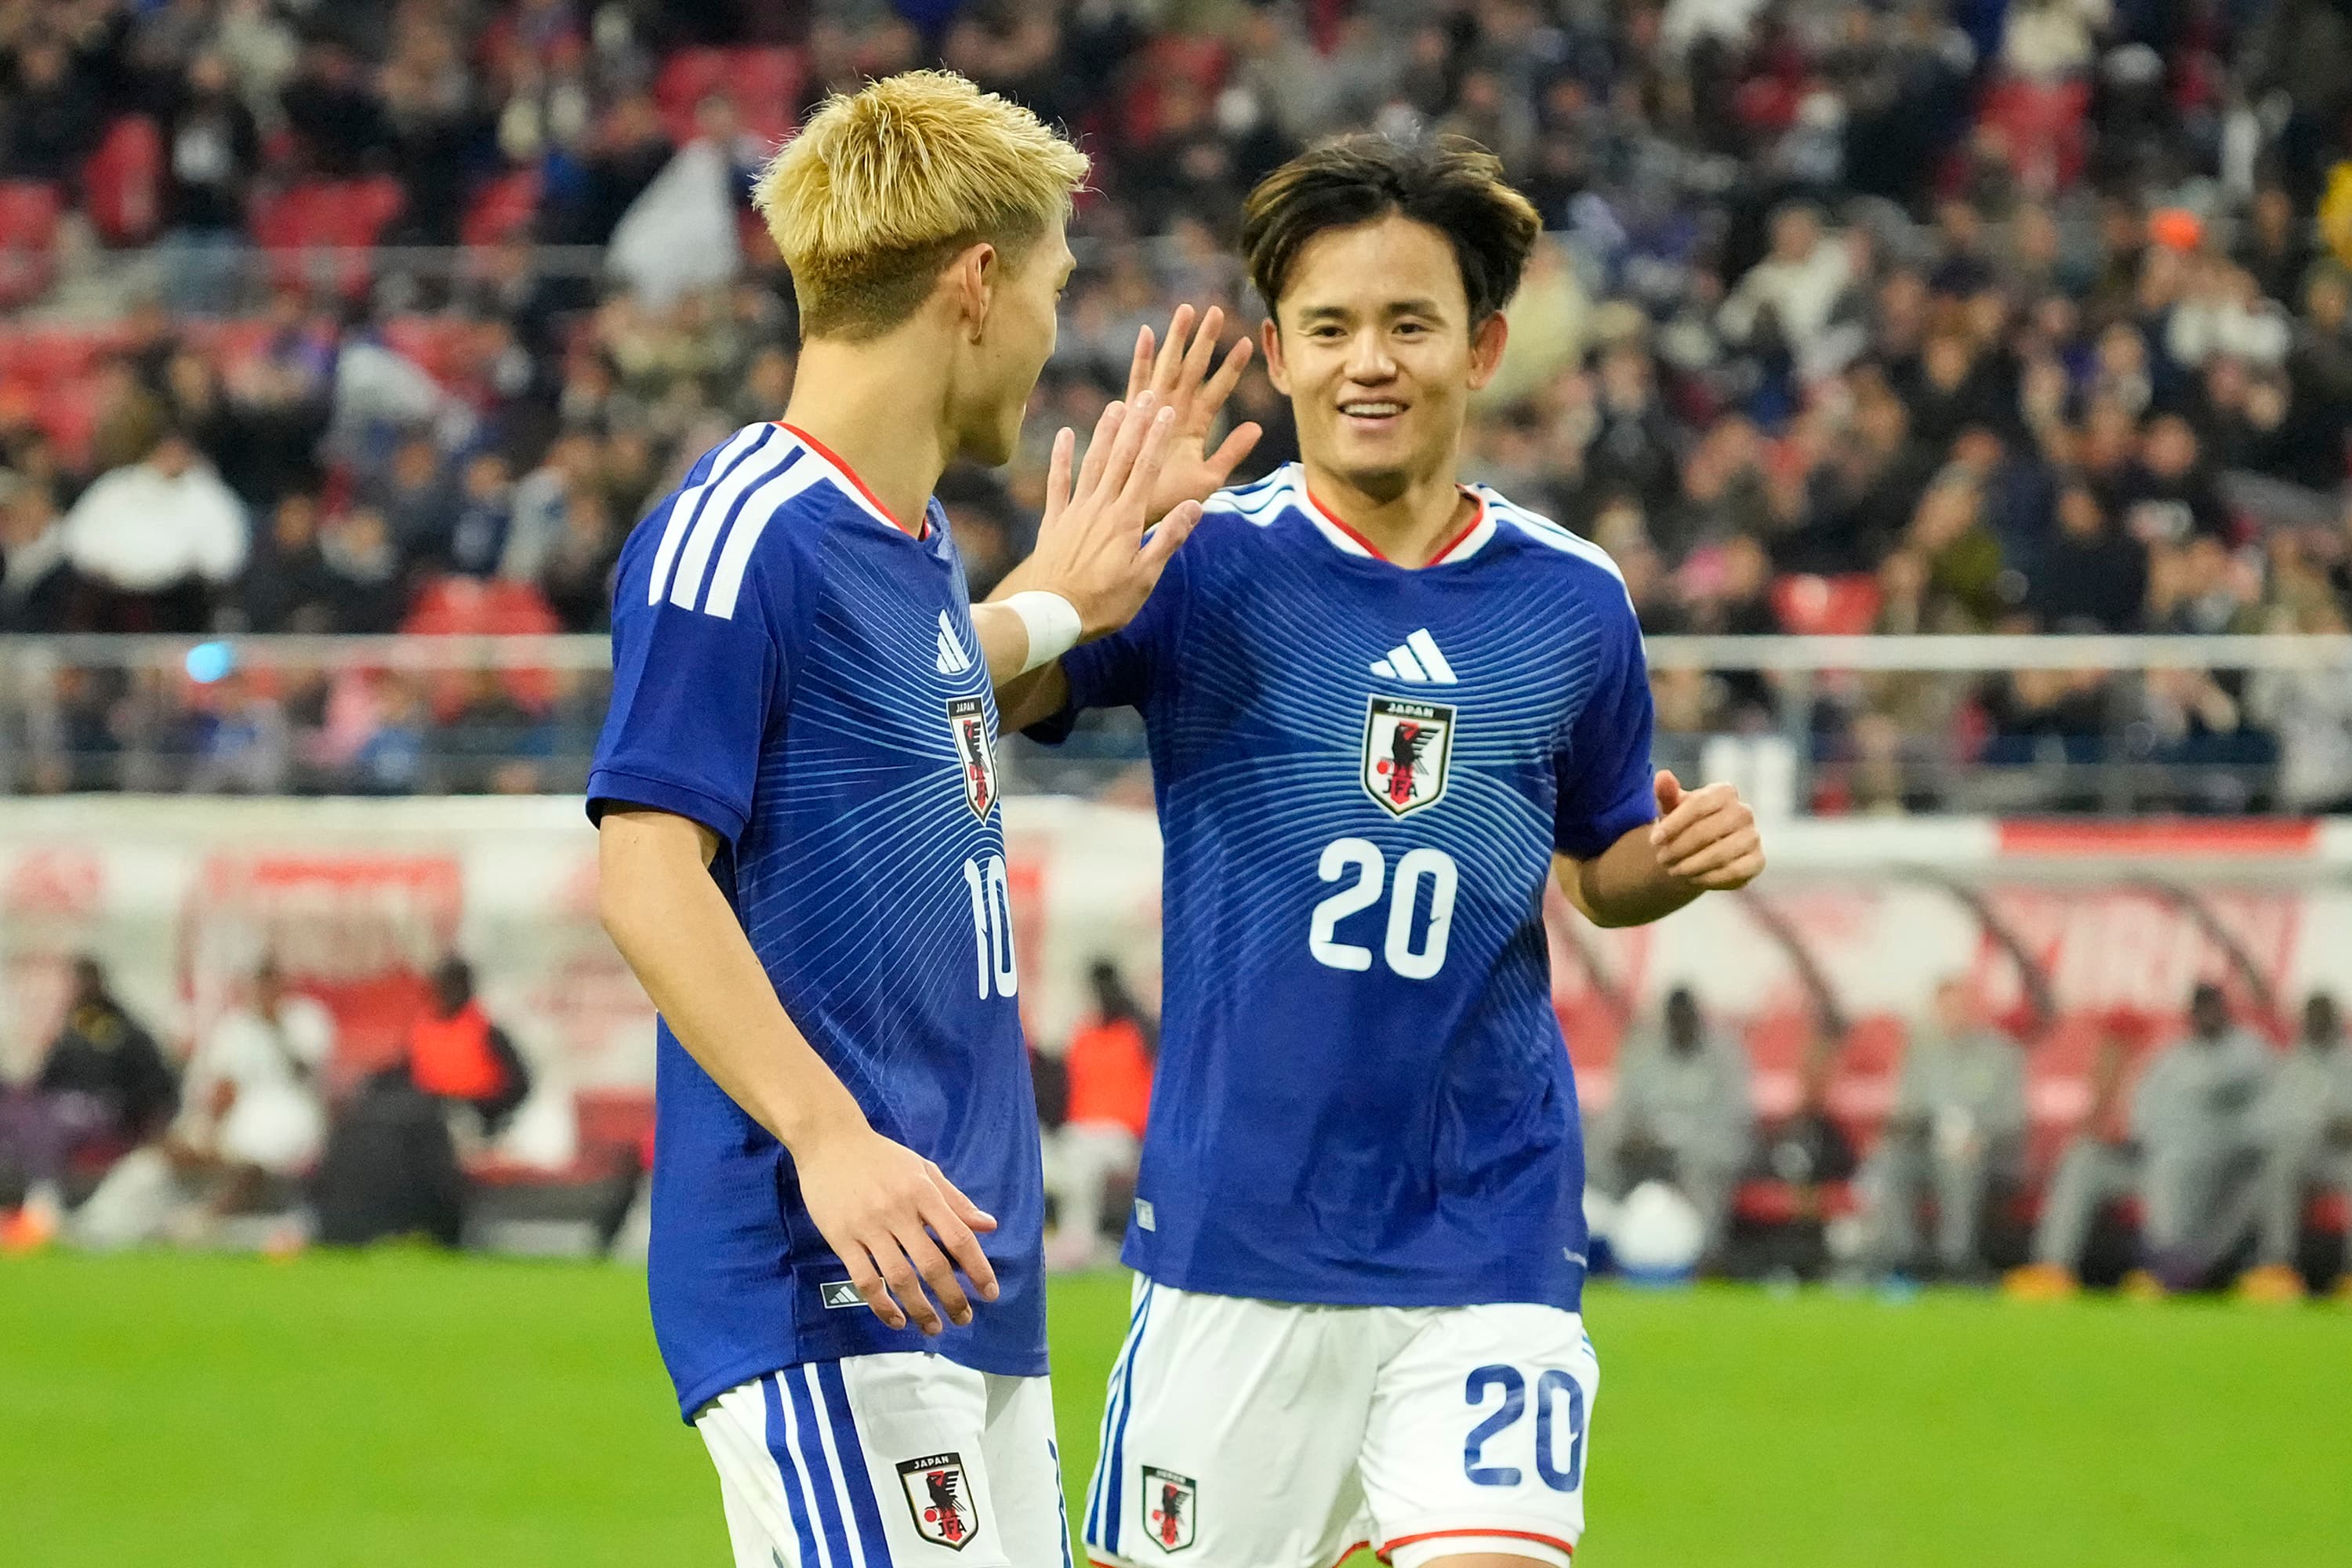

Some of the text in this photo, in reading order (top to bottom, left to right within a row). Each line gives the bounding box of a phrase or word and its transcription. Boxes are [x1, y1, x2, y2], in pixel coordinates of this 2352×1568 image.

[956, 702, 975, 713] JAPAN
[1387, 702, 1435, 717] JAPAN
[1382, 779, 1418, 797] JFA
[1308, 837, 1459, 980] 20
[964, 855, 1018, 1000] 10
[1464, 1364, 1584, 1492] 20
[914, 1456, 949, 1469] JAPAN
[938, 1519, 967, 1537] JFA
